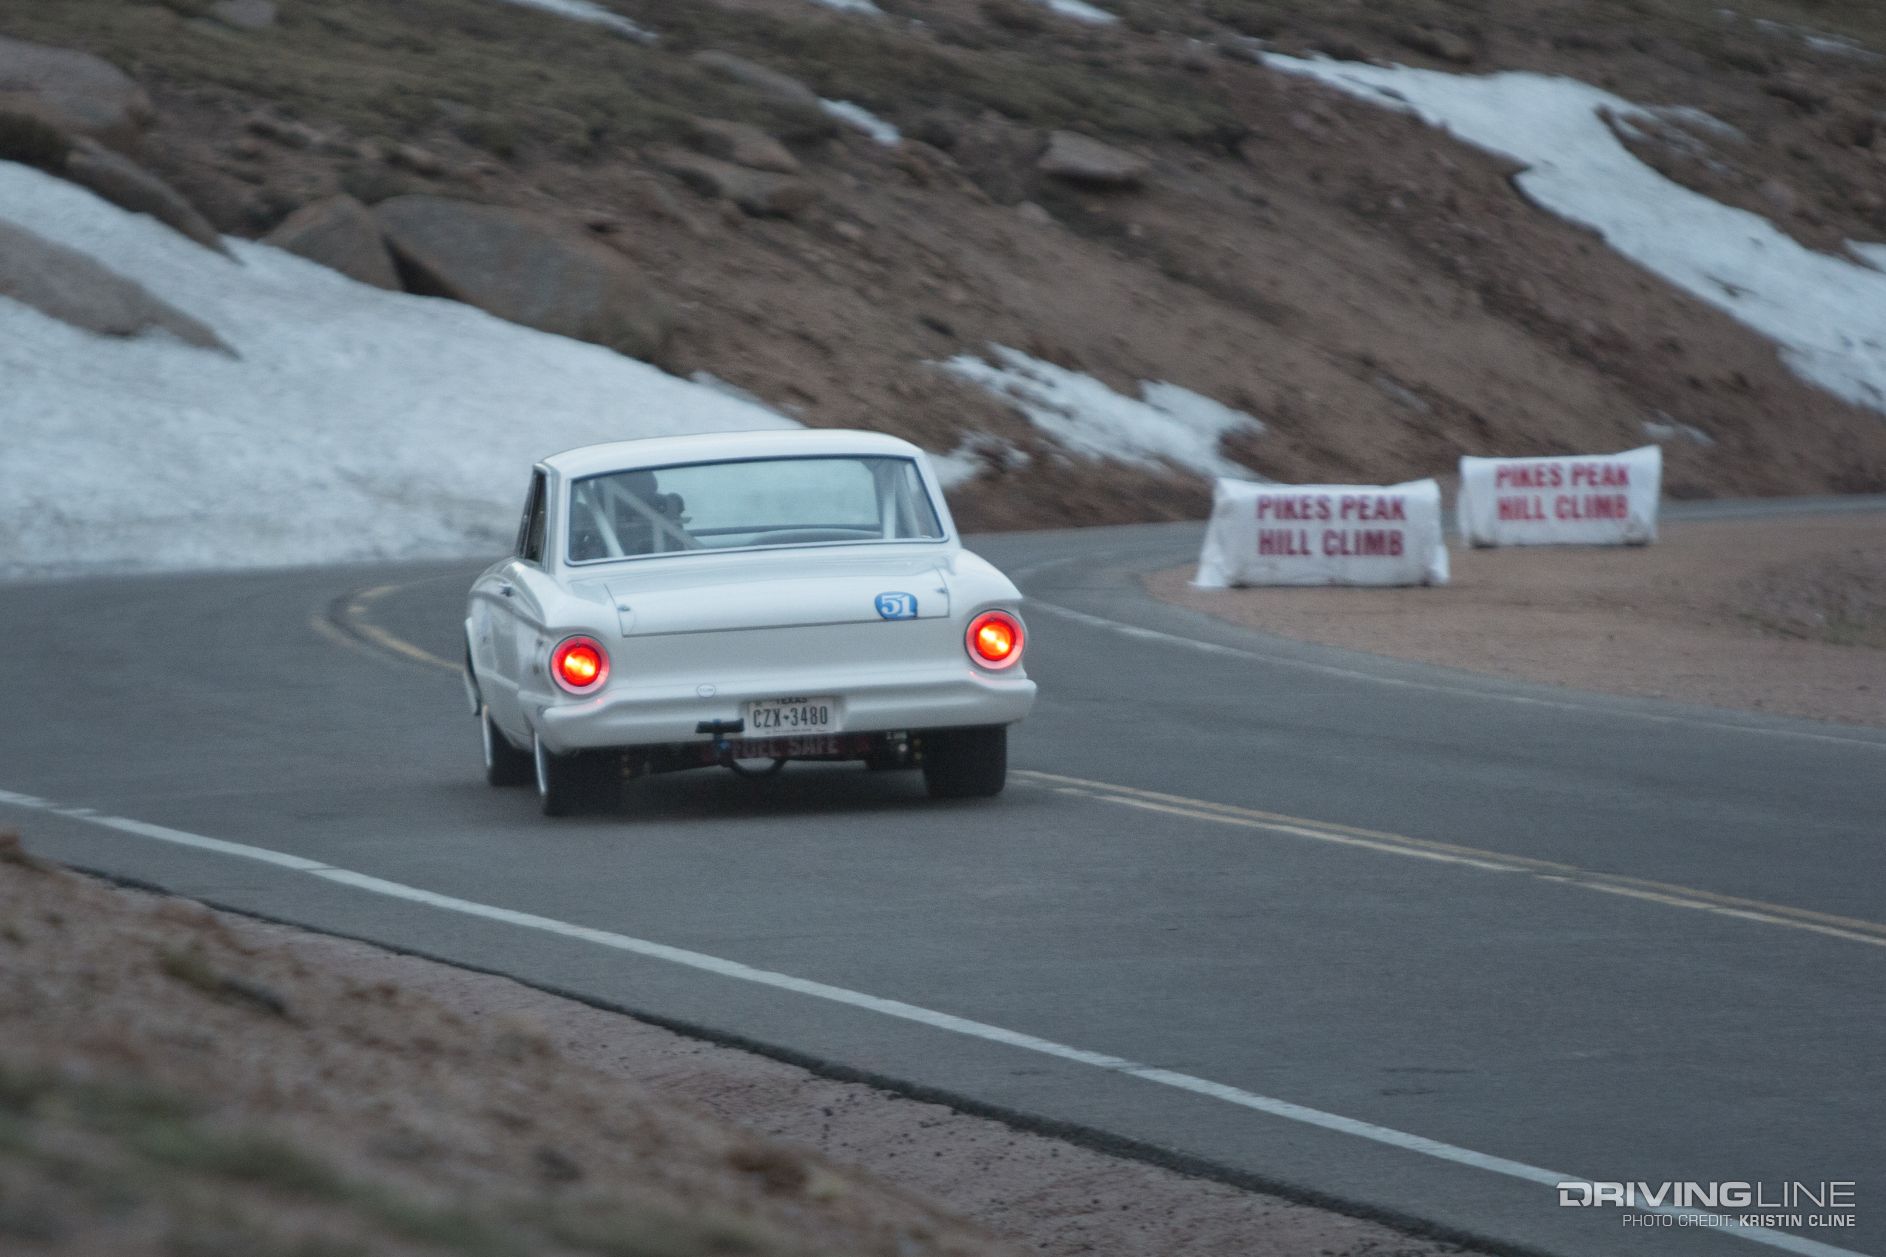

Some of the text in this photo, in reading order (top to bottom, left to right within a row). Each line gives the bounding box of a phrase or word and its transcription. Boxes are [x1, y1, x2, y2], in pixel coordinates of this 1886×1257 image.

[1496, 462, 1629, 487] PIKES PEAK
[1256, 494, 1406, 520] PIKES PEAK
[1497, 494, 1628, 520] HILL CLIMB
[1258, 528, 1404, 556] HILL CLIMB
[880, 594, 916, 618] 51
